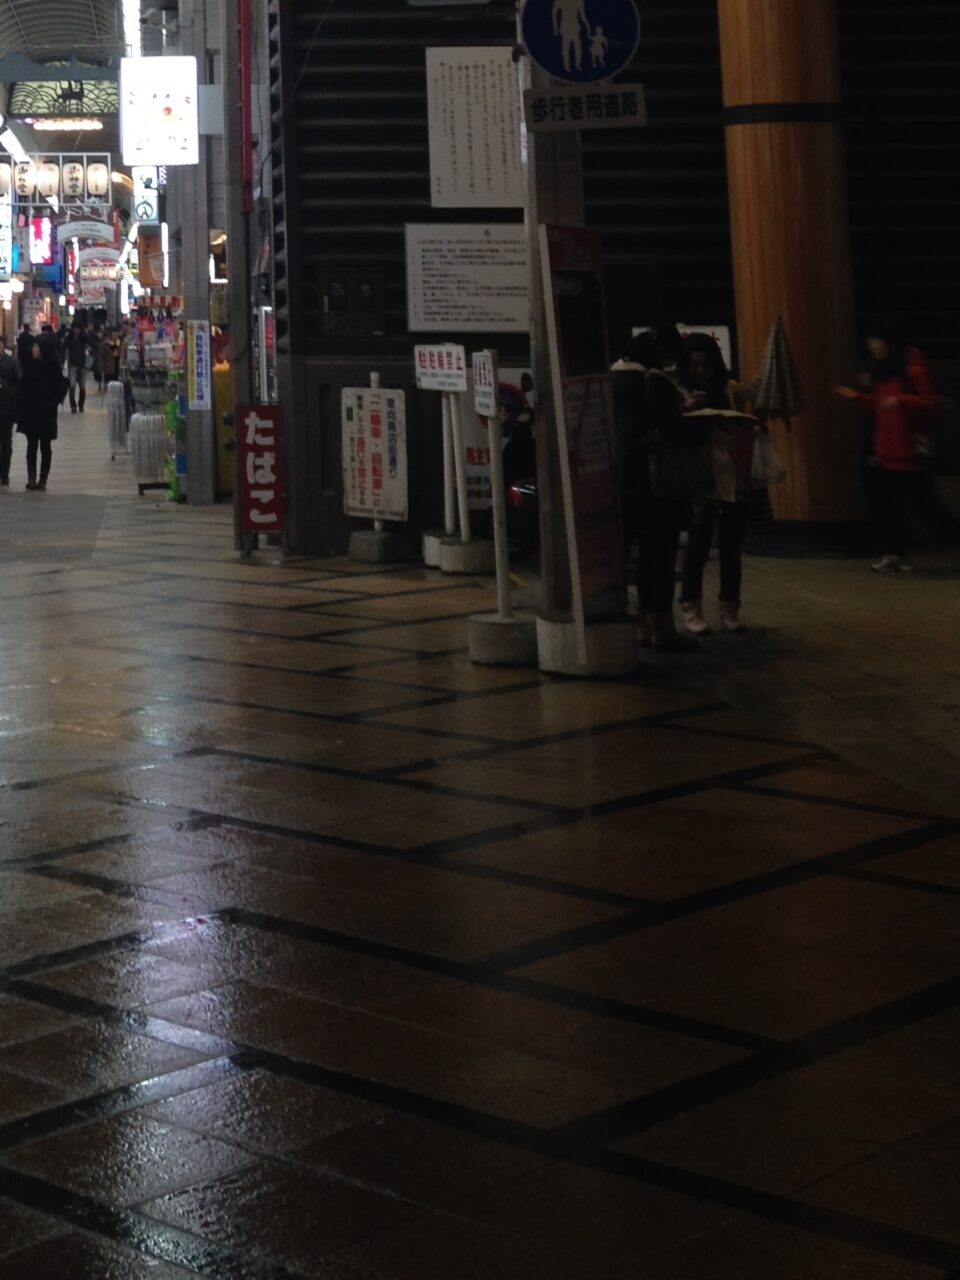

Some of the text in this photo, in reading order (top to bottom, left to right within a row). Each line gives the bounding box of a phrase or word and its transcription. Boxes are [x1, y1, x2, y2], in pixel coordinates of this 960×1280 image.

[532, 91, 638, 123] 歩行者用道路
[244, 410, 278, 524] たばこ
